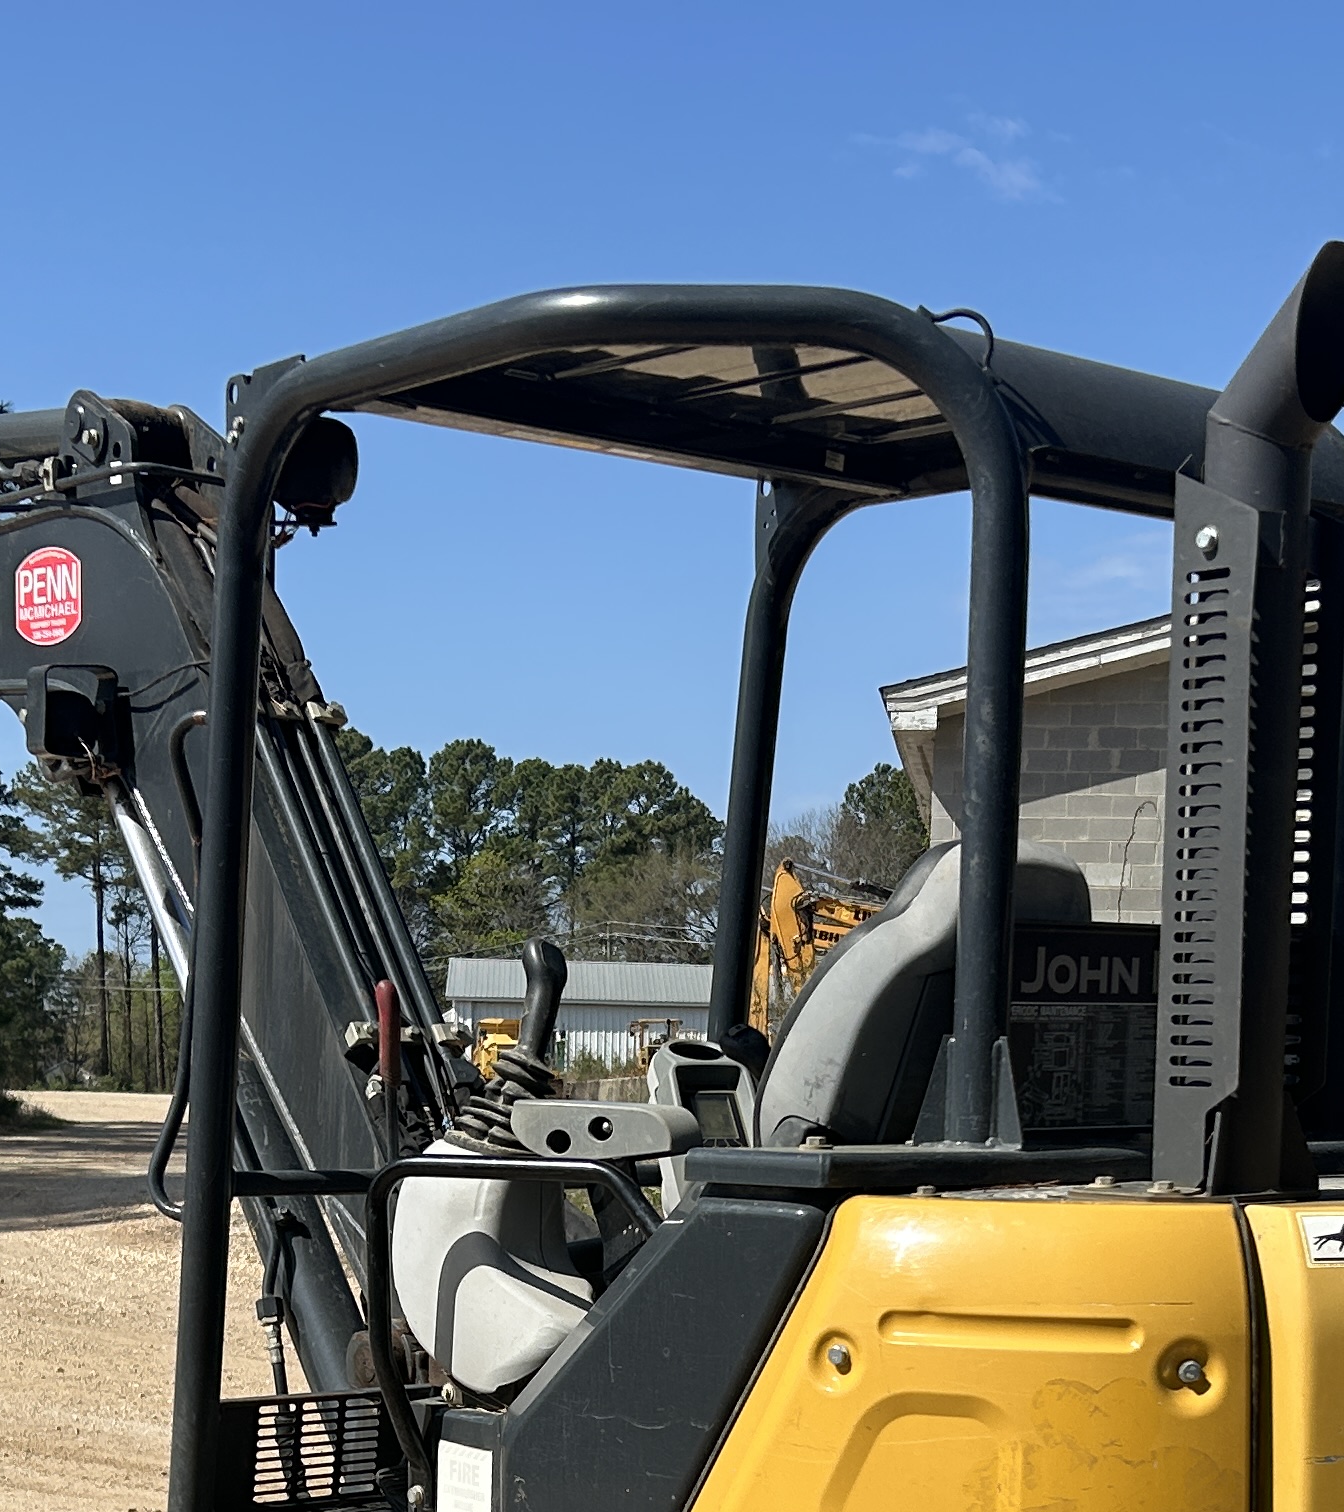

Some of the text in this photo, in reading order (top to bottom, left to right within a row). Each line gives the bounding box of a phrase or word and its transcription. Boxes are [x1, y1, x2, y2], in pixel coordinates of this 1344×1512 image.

[19, 561, 77, 607] PENN
[19, 601, 79, 621] MCMICHAEL
[1020, 946, 1141, 994] JOHN
[449, 1459, 480, 1487] FIRE
